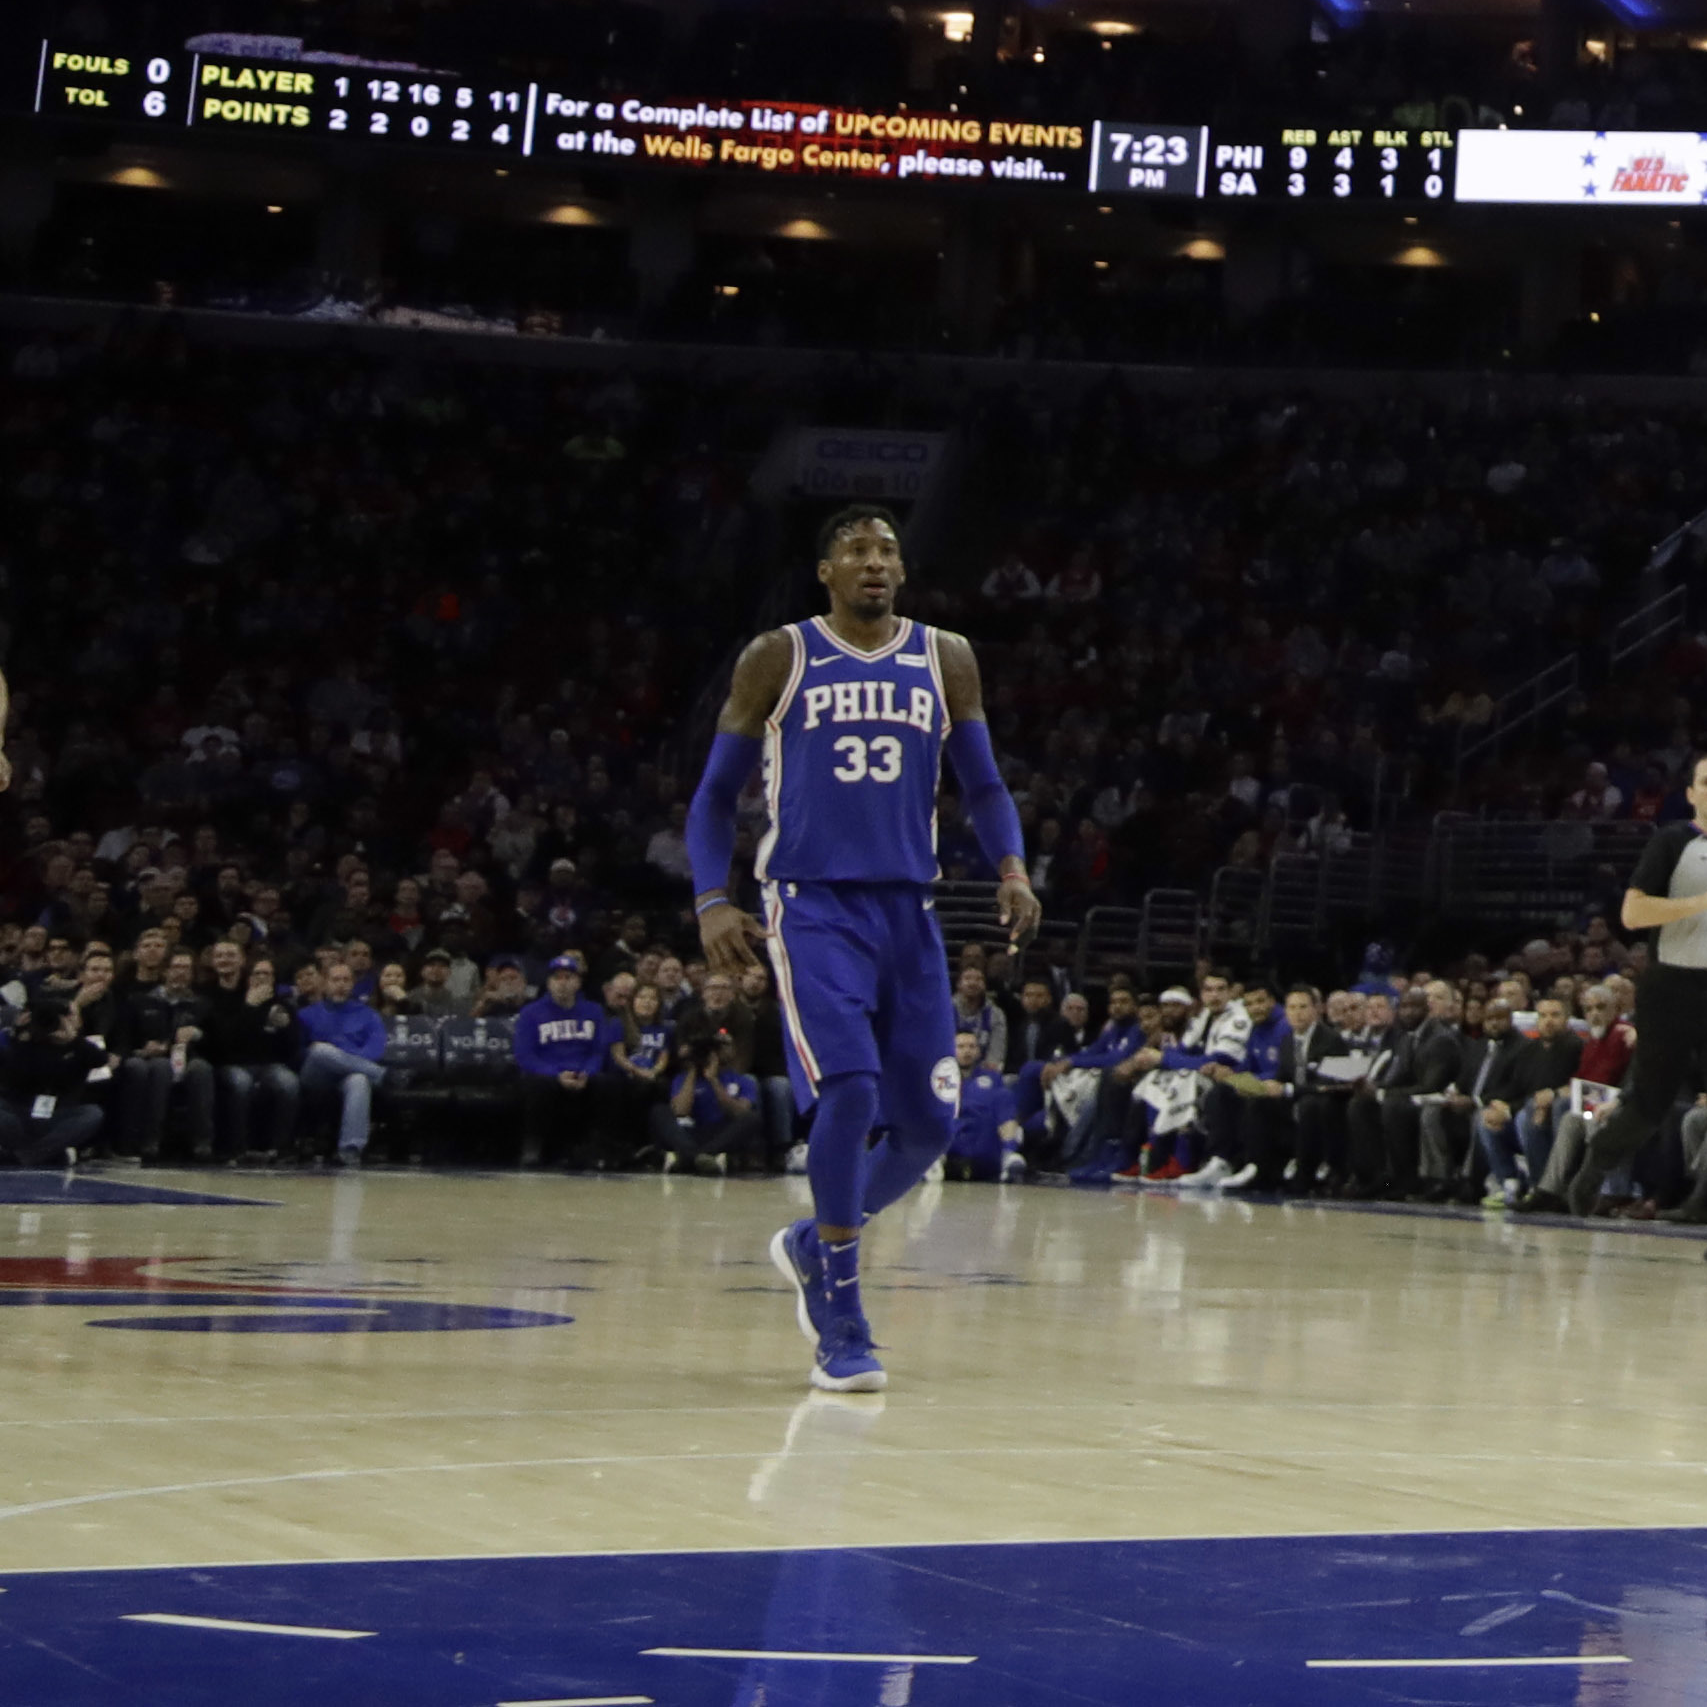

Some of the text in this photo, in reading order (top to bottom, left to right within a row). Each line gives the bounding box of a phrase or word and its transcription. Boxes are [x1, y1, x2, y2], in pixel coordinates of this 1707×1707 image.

[53, 53, 170, 83] FOULS 0
[65, 87, 165, 116] TOL 6
[202, 65, 519, 112] PLAYER 1 12 16 5 11
[204, 98, 509, 144] POINTS 2 2 0 2 4
[546, 93, 1082, 148] For a Complete List of UPCOMING EVENTS
[1110, 133, 1188, 165] 7:23
[1282, 130, 1453, 147] REB AST BLK STL
[558, 130, 1065, 180] at the Wells Fargo Center, please visit...
[1216, 146, 1441, 171] PHI 9 4 3 1
[1129, 168, 1165, 188] PM
[1220, 172, 1442, 197] SA 3 3 1 0
[816, 439, 928, 463] GEICO
[803, 681, 934, 733] PHILA
[833, 735, 903, 783] 33
